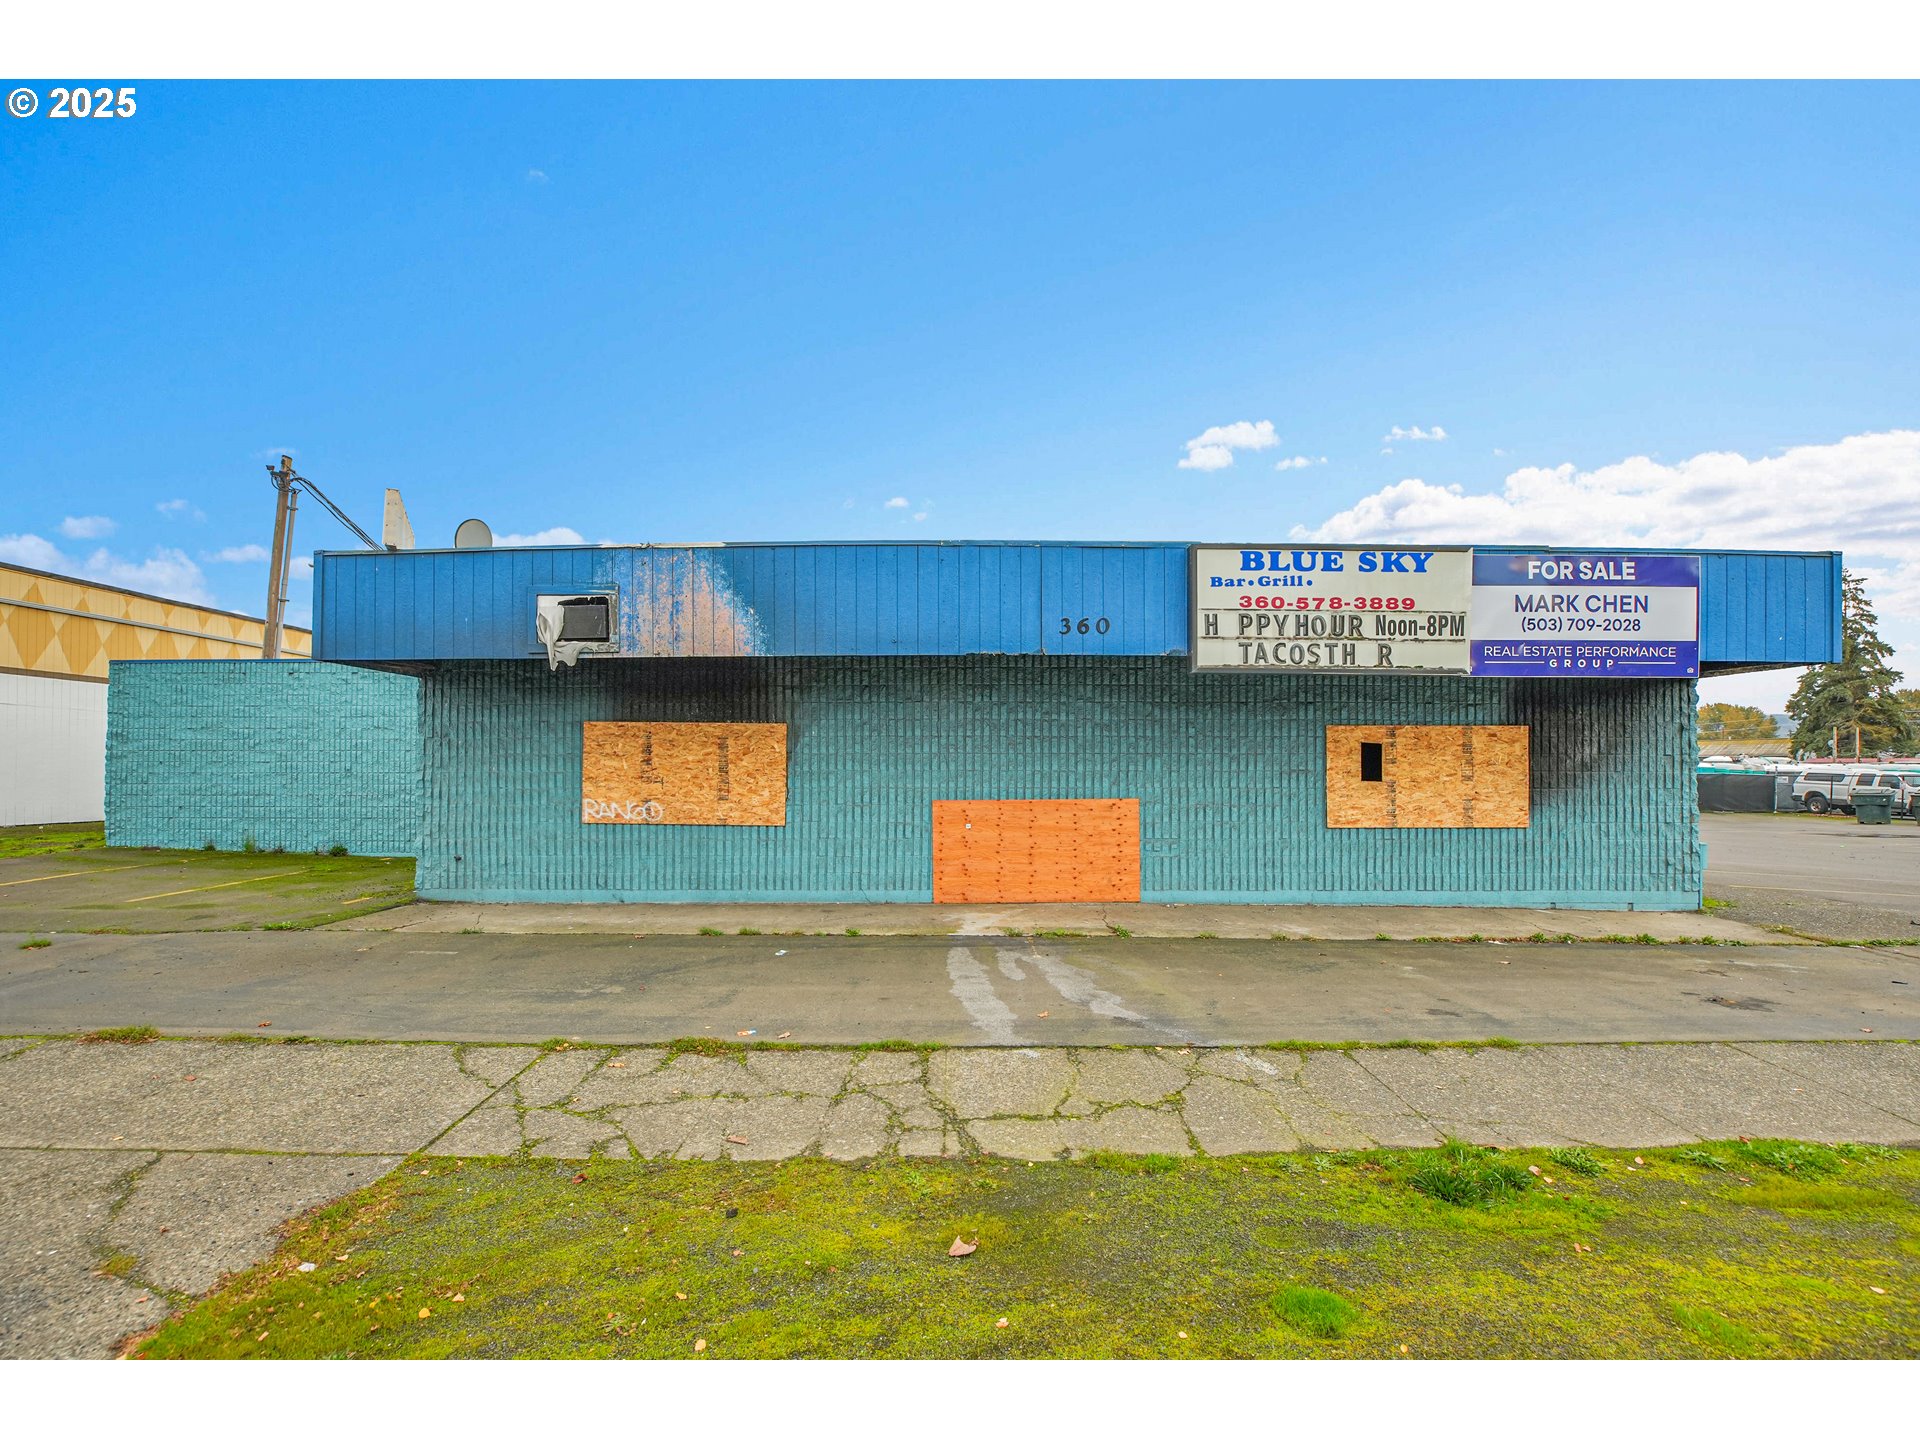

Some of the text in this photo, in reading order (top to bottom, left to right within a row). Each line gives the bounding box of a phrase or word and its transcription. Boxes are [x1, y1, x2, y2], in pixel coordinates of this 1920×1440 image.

[1239, 550, 1435, 573] BLUE SKY
[1528, 560, 1636, 581] FOR SALE
[1238, 595, 1416, 611] 360-578-3889
[1514, 594, 1649, 614] MARK CHEN
[1058, 617, 1111, 635] 360
[1375, 614, 1465, 637] Noon-8PM
[1521, 616, 1641, 633] (503) 709-2028
[1484, 645, 1677, 658] REAL ESTATE PERFORMANCE
[1549, 658, 1615, 669] GROUP
